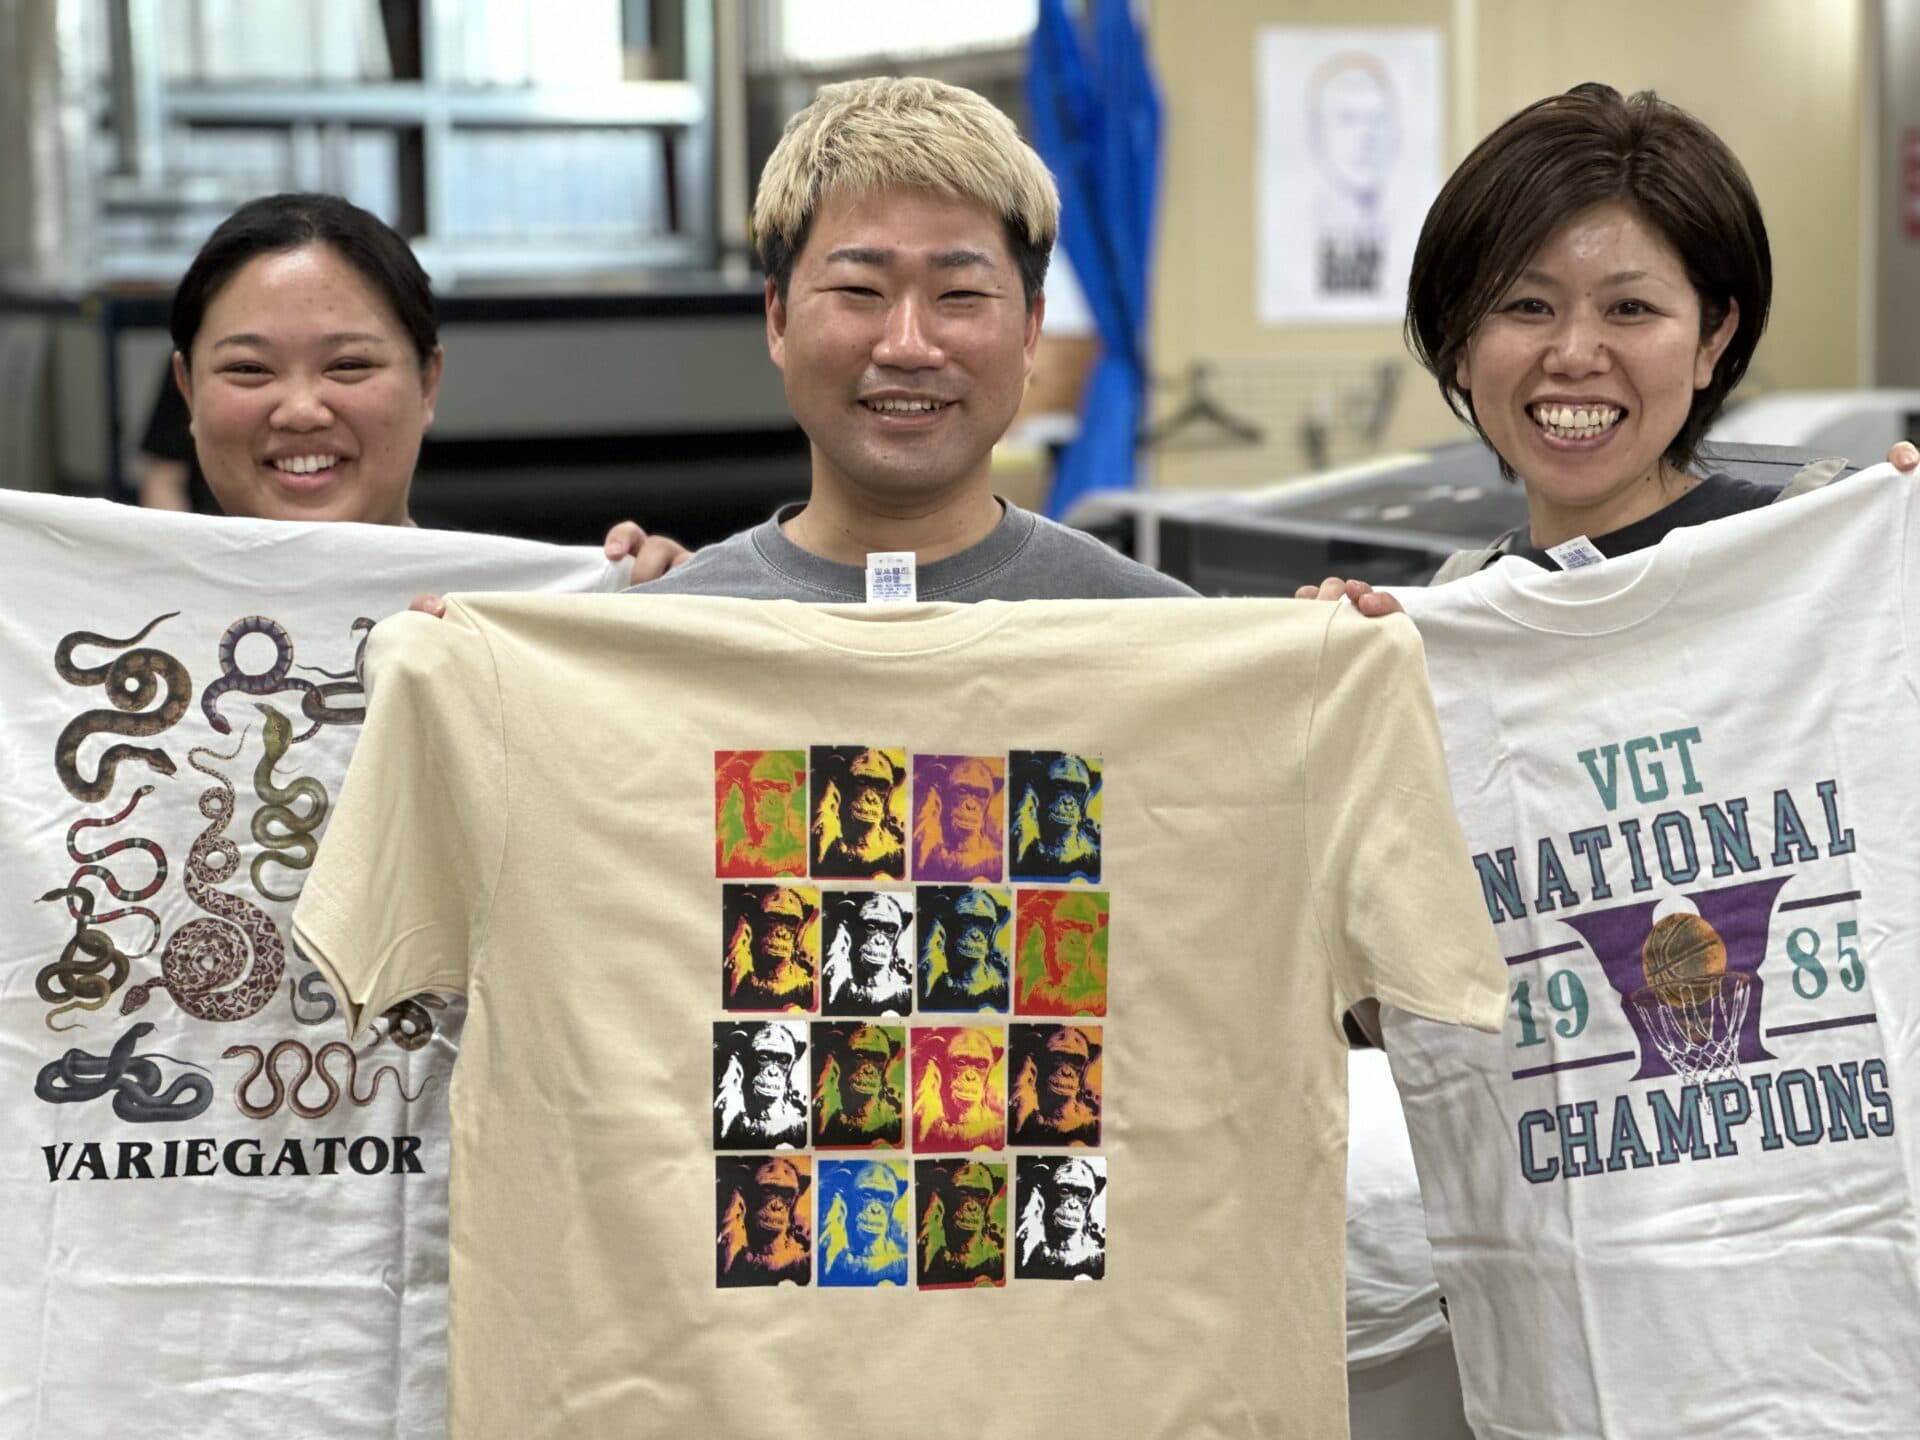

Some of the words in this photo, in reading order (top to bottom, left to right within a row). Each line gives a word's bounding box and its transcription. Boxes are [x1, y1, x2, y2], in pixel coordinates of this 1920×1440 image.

[1577, 726, 1704, 811] VGT
[1472, 779, 1857, 925] NATIONAL
[1510, 968, 1591, 1049] 19
[1785, 919, 1866, 1001] 85
[41, 1135, 426, 1183] VARIEGATOR
[1518, 1058, 1895, 1185] CHAMPIONS
